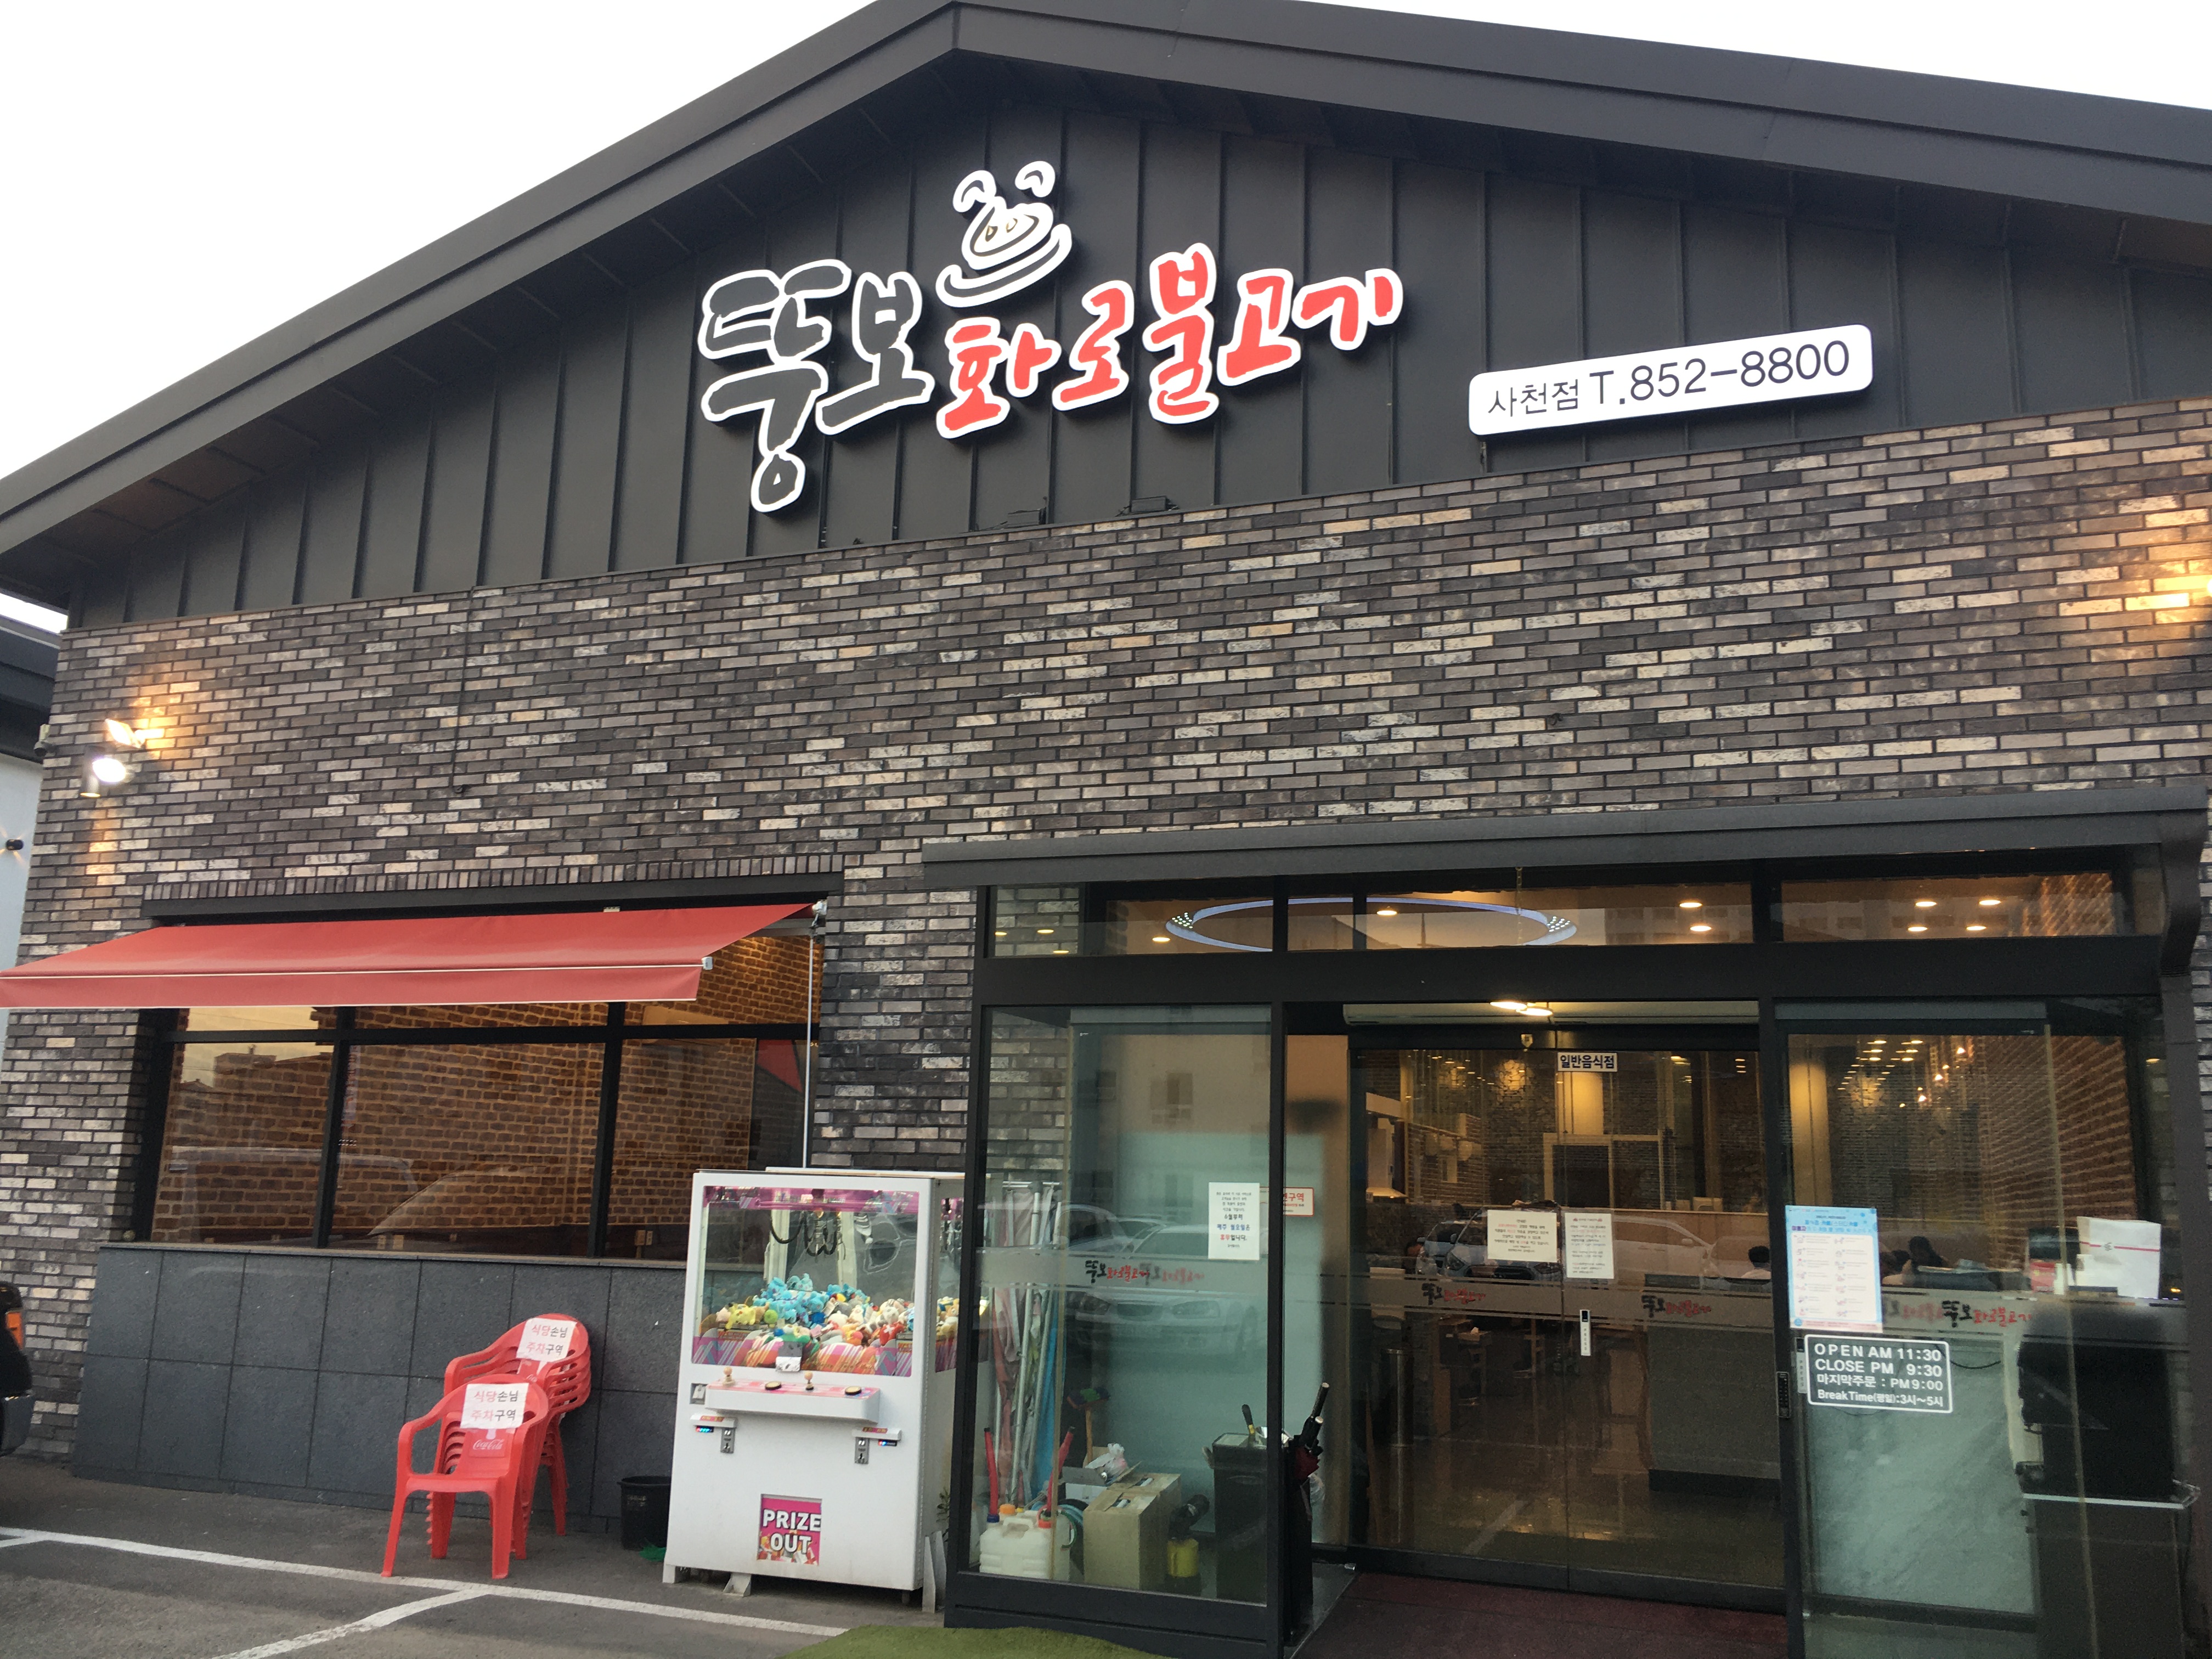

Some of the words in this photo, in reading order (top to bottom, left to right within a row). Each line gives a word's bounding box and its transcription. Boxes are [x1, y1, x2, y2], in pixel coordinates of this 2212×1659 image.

[1487, 379, 1579, 417] 사천점
[1589, 340, 1849, 405] T.852-8800
[1560, 1054, 1615, 1069] 일반음식점
[532, 1324, 568, 1338] 식당손님
[526, 1342, 563, 1356] 주차구역
[1814, 1343, 1864, 1357] OPEN
[1868, 1346, 1892, 1359] AM
[1897, 1348, 1942, 1362] 11:30
[1815, 1358, 1865, 1373] CLOSE
[1871, 1361, 1894, 1374] PM
[1906, 1363, 1943, 1378] 9:30
[1816, 1373, 1877, 1388] 마지막주문
[474, 1390, 518, 1403] 식당손님
[471, 1409, 516, 1422] 주차구역
[763, 1509, 822, 1532] PRIZE
[770, 1532, 812, 1554] OUT
